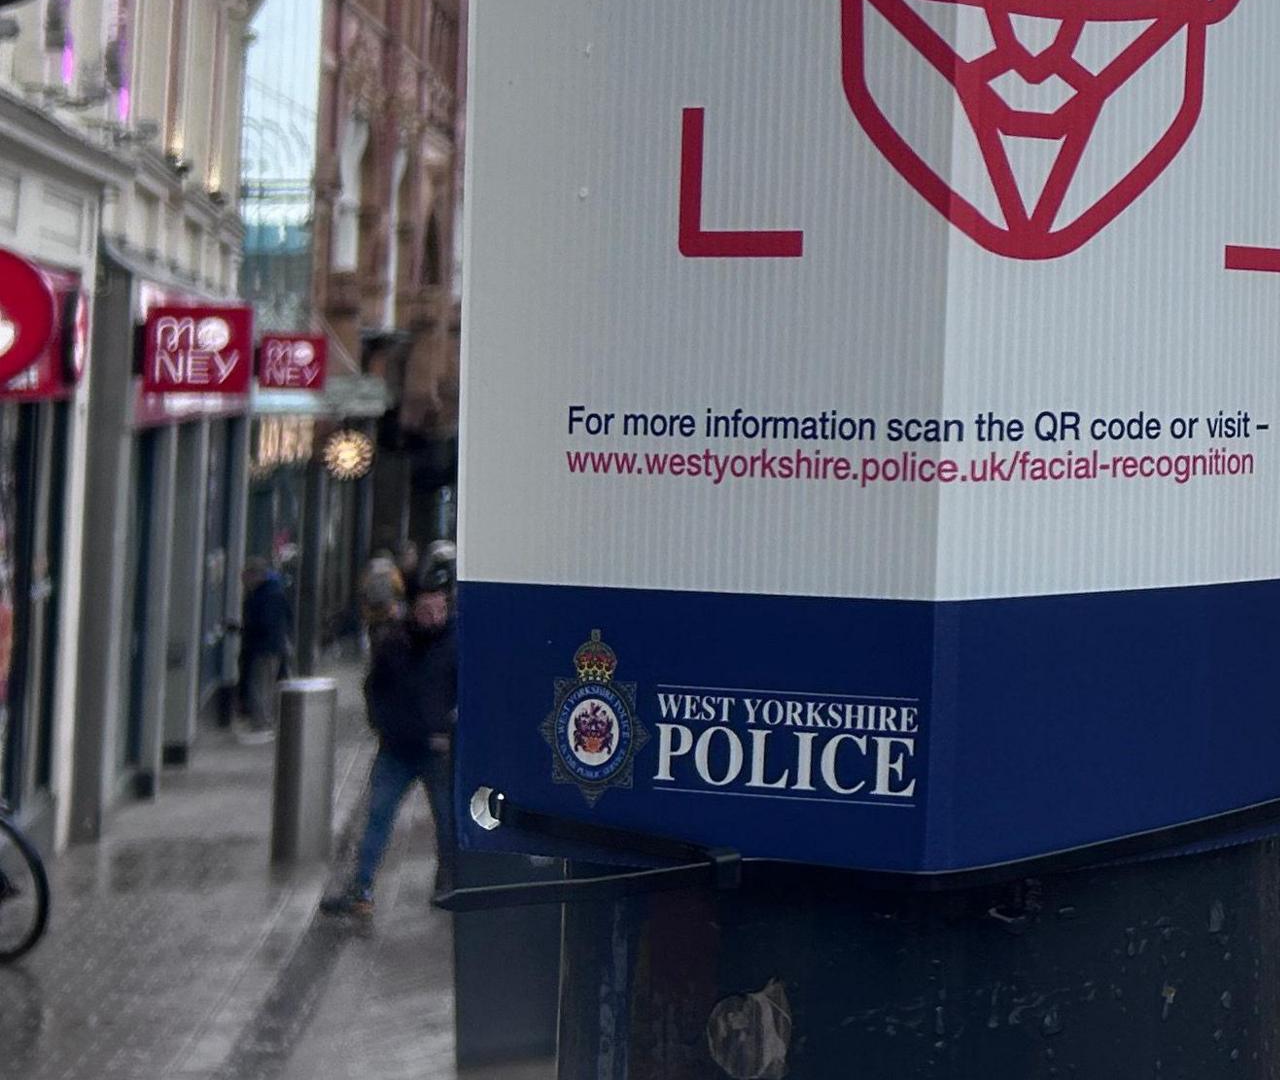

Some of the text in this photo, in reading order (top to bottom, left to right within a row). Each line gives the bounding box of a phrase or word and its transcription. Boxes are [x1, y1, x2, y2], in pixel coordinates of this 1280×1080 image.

[567, 405, 615, 436] For
[623, 412, 696, 437] more
[704, 407, 877, 442] information
[886, 417, 965, 443] scan
[974, 412, 1025, 442] the
[1033, 410, 1081, 442] QR
[1089, 410, 1162, 440] code
[1169, 418, 1199, 439] or
[1206, 409, 1251, 439] visit
[567, 447, 1254, 487] www.westyorkshire.police.uk/facial-recognition
[656, 693, 919, 733] WEST YORKSHIRE
[652, 722, 917, 798] POLICE
